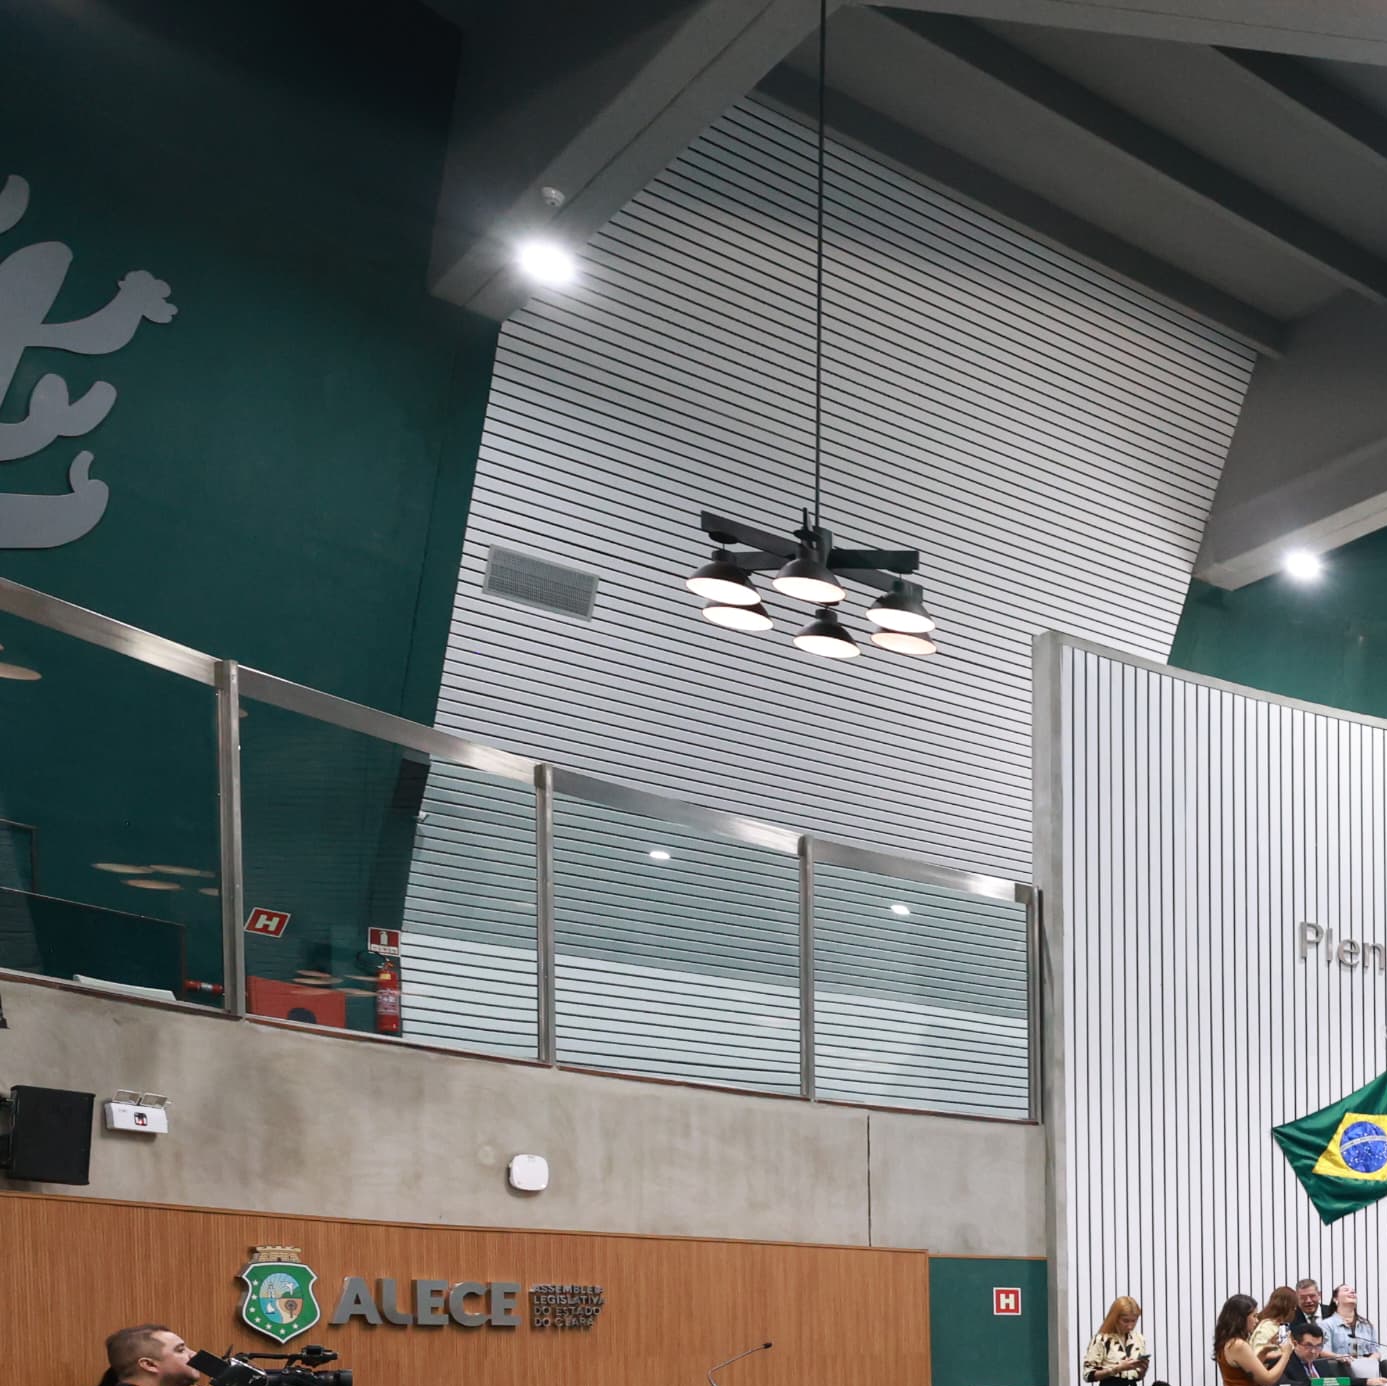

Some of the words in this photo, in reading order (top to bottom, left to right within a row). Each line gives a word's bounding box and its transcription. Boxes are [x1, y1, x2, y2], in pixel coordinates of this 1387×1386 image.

[256, 914, 280, 931] H
[327, 1276, 522, 1328] ALECE
[1000, 1293, 1015, 1310] H
[534, 1306, 551, 1315] DO
[534, 1318, 551, 1327] DO
